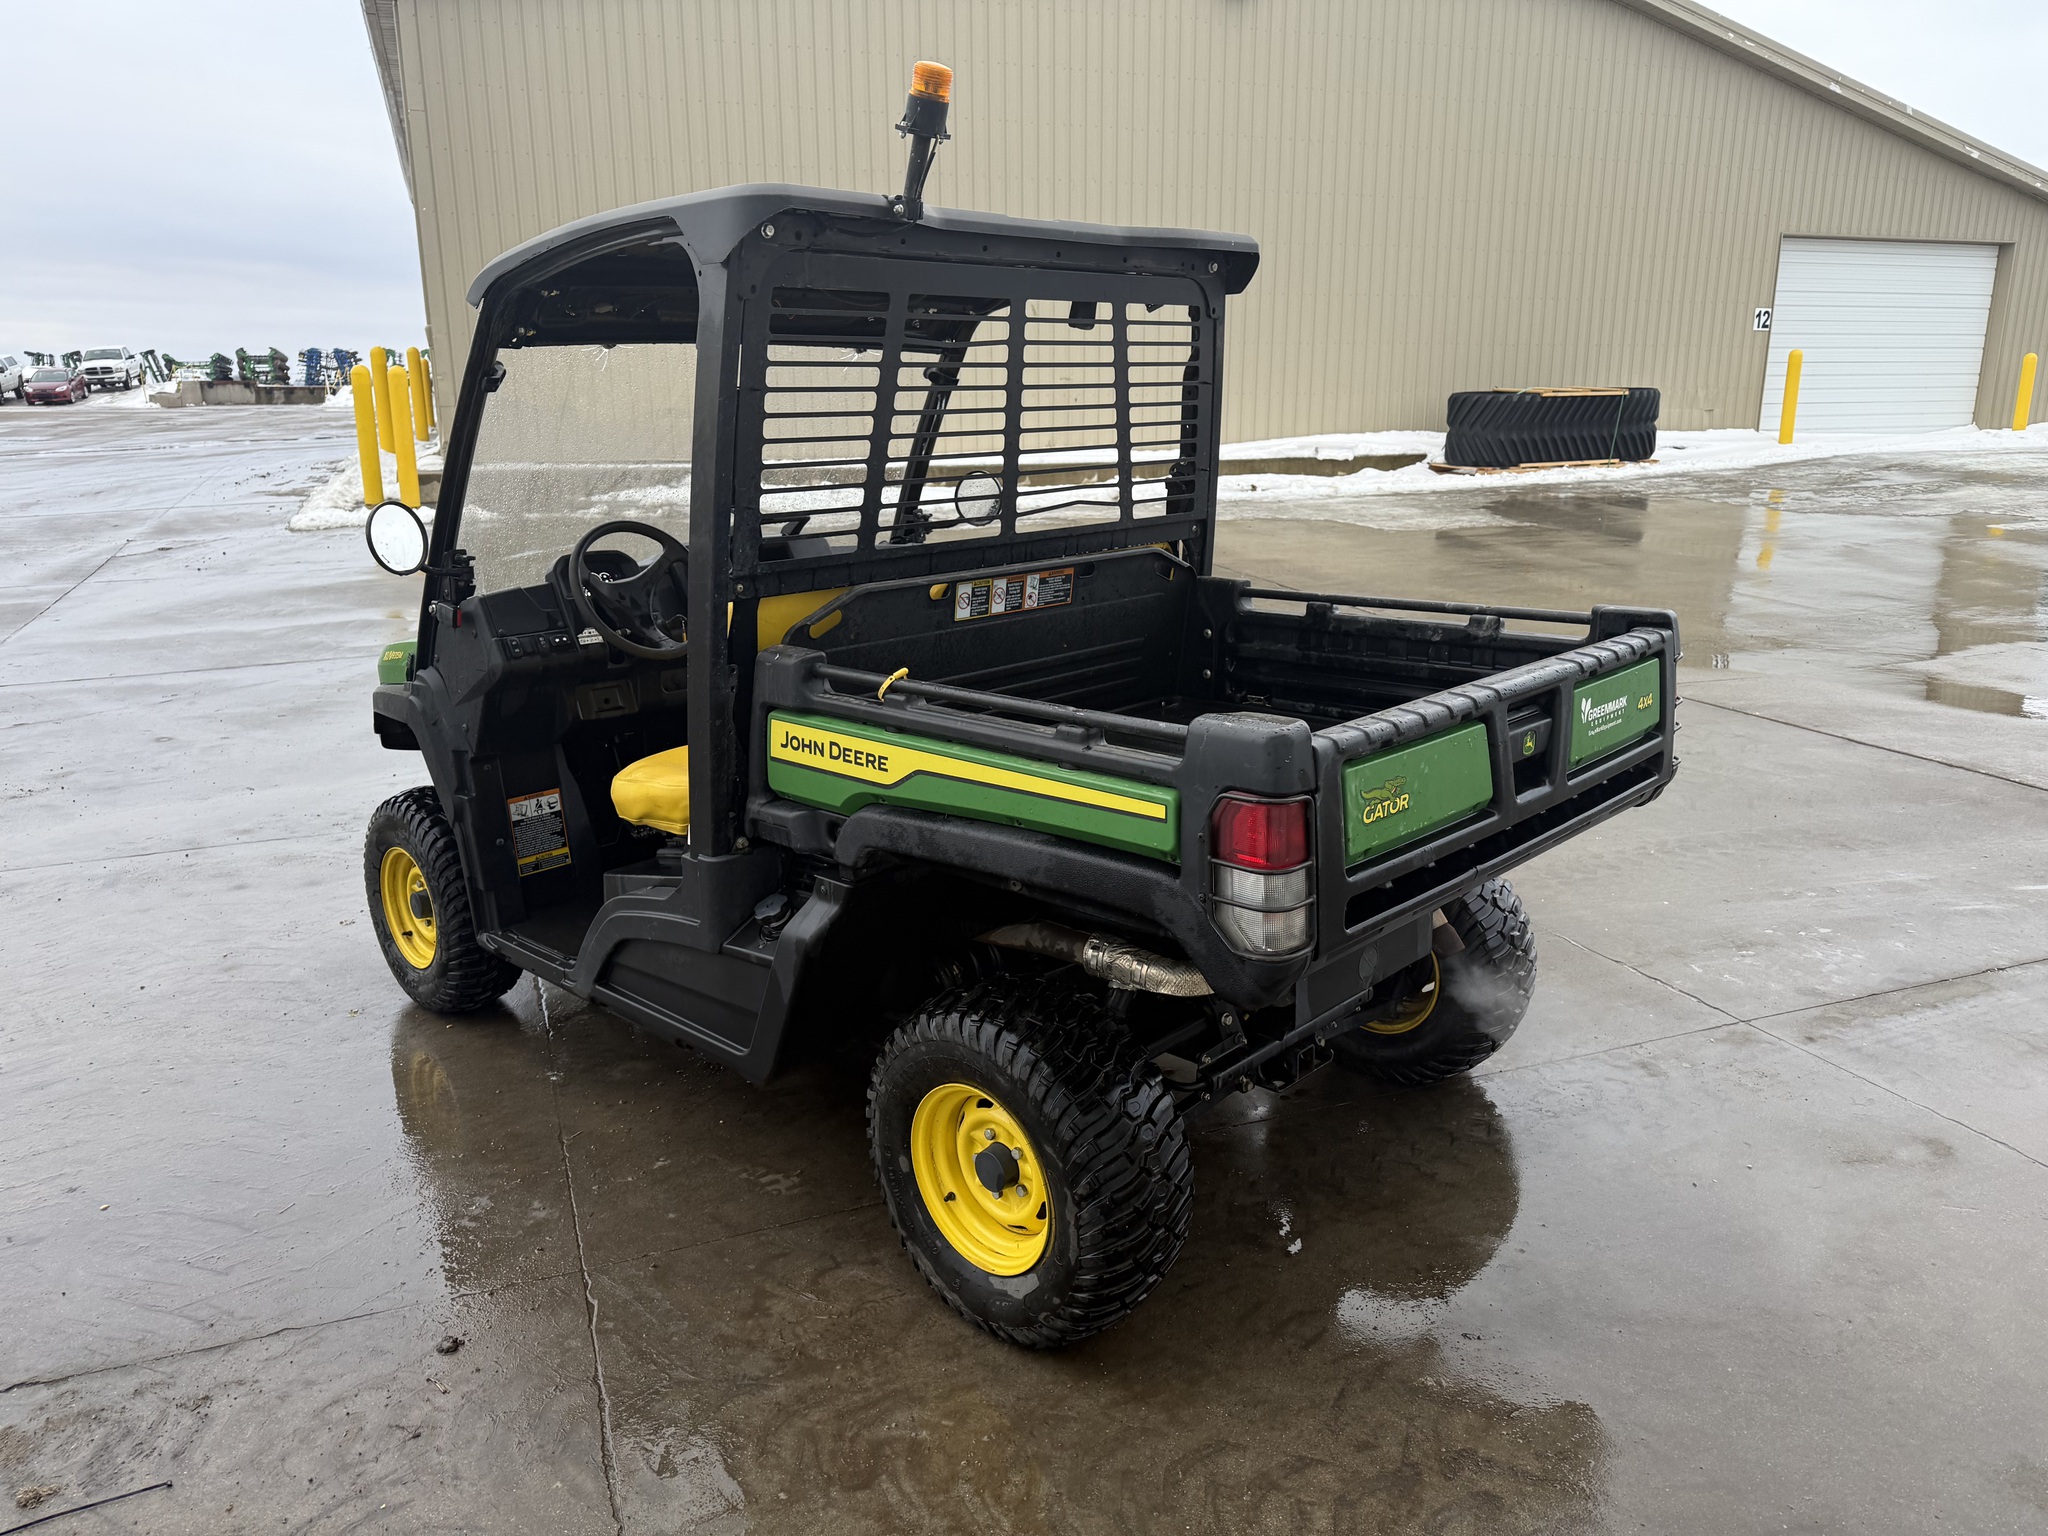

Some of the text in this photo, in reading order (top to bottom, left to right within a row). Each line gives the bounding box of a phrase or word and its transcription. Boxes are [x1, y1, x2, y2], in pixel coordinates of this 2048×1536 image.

[1755, 310, 1770, 328] 12
[1588, 695, 1627, 721] GREENMARK
[780, 730, 889, 773] JOHN DEERE
[1363, 793, 1410, 824] GATOR
